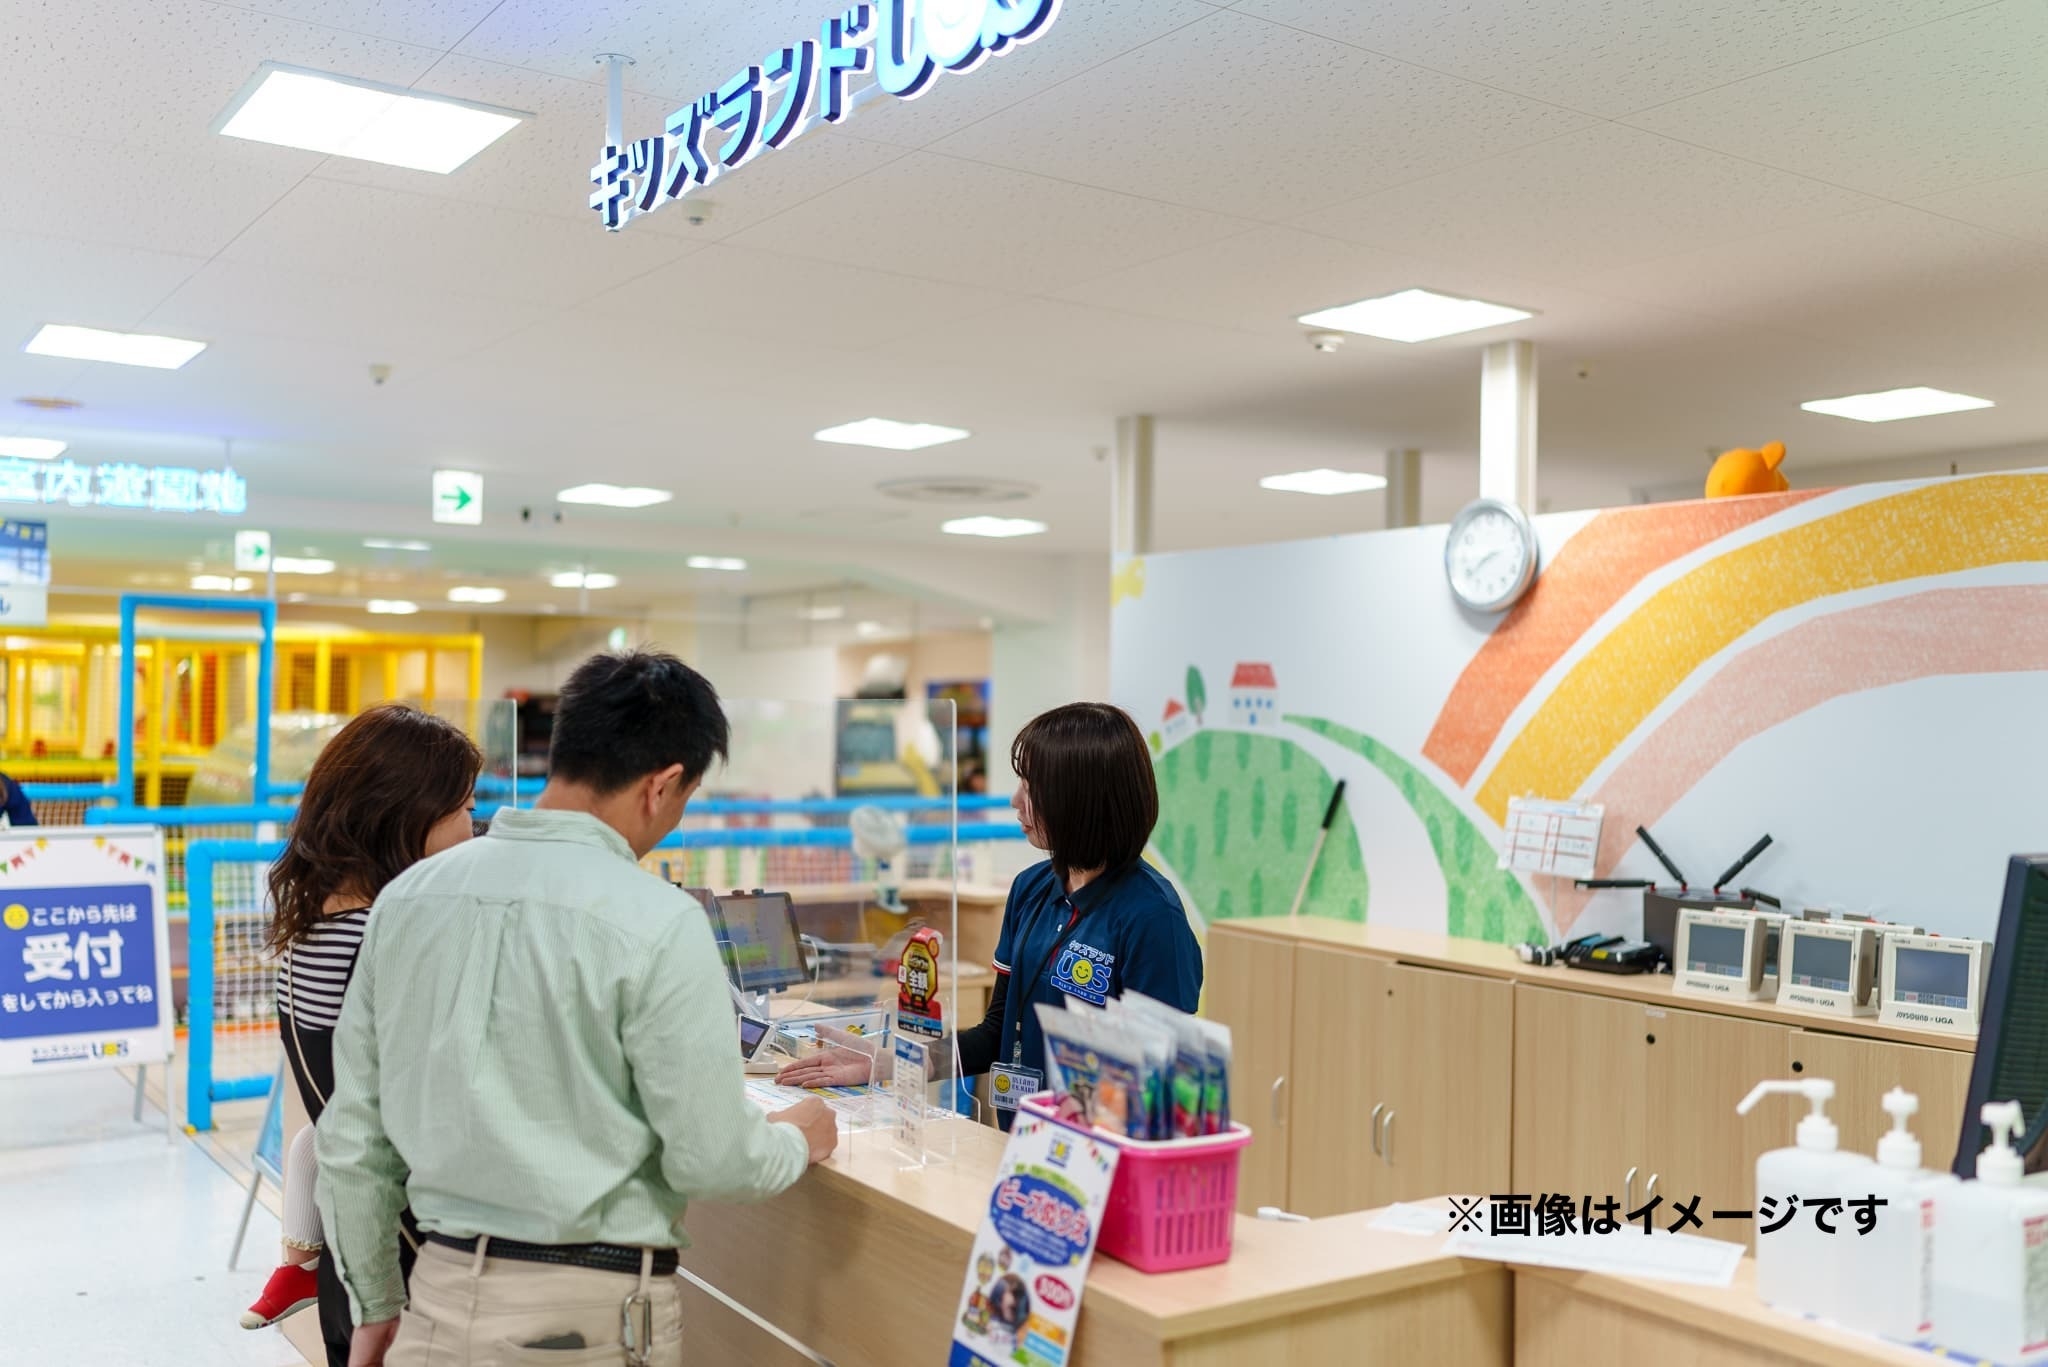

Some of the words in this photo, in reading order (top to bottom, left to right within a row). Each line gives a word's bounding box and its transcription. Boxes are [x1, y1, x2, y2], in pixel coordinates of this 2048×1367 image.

[590, 3, 874, 231] キッズランド
[32, 903, 137, 927] ここから先は
[22, 929, 124, 983] 受付
[1069, 939, 1115, 966] キッズランド
[1, 983, 153, 1013] をしてから入ってね
[1896, 1010, 1929, 1022] JOYSOUND
[1935, 1016, 1954, 1026] UGA
